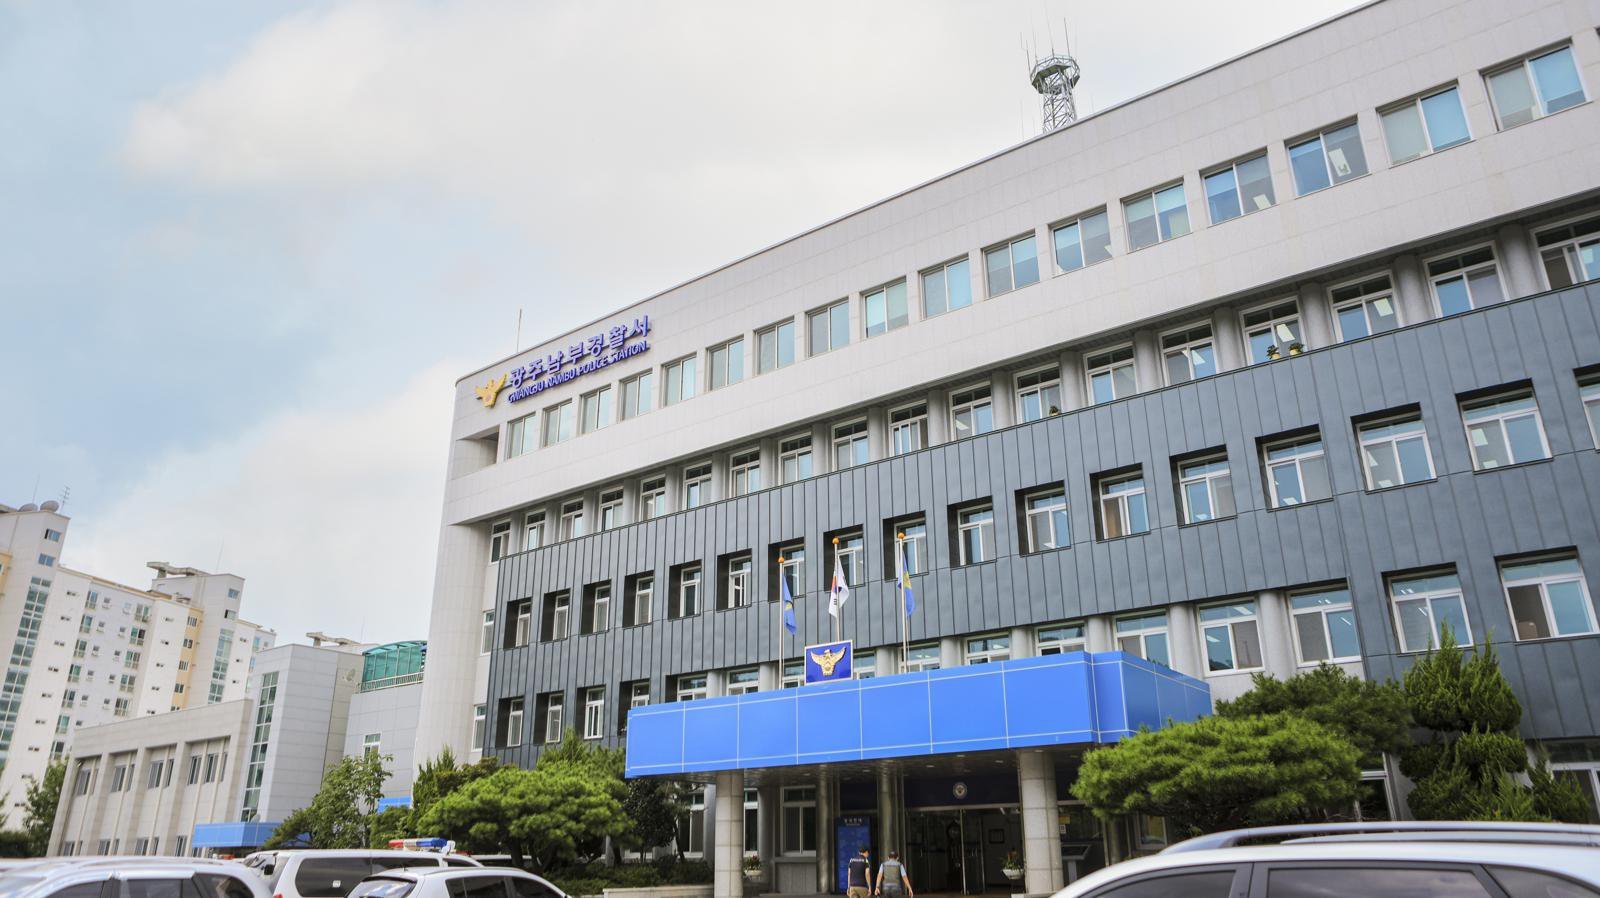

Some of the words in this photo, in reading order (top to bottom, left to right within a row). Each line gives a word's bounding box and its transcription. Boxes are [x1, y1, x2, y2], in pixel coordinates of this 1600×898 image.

[508, 381, 545, 403] GWANGJU
[547, 369, 577, 388] NAMBU
[578, 356, 608, 377] POLICE
[608, 340, 648, 363] STATION
[510, 315, 648, 388] 광주남부경찰서
